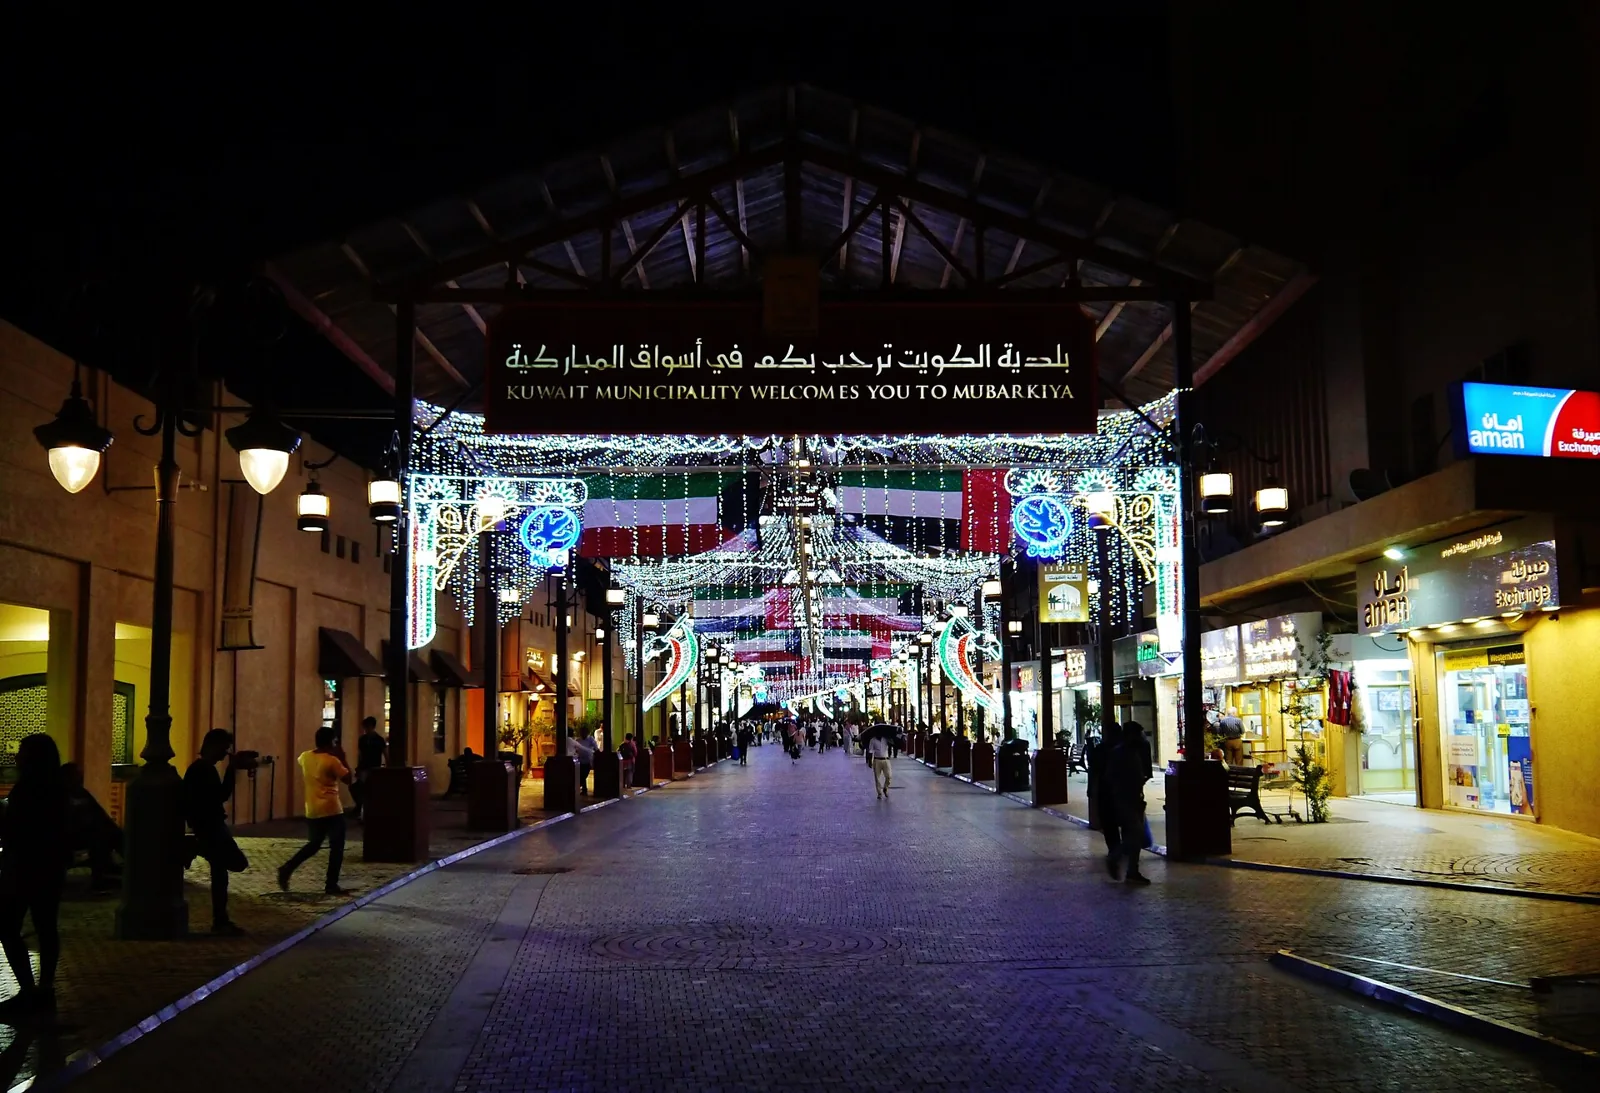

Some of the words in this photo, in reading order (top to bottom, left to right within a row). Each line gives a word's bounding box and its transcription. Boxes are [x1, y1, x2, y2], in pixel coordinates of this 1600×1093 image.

[505, 342, 624, 376] المباركية
[629, 336, 703, 376] أسواق
[706, 343, 743, 376] في
[752, 342, 816, 375] بكم
[821, 342, 893, 376] ترحب
[897, 342, 991, 377] الكويت
[997, 341, 1071, 376] بلدية
[506, 384, 590, 401] KUWAIT
[595, 384, 743, 401] MUNICIPALITY
[750, 384, 860, 401] WELCOMES
[867, 384, 910, 400] YOU
[916, 384, 948, 400] TO
[953, 384, 1075, 400] MUBARKIYA
[1470, 429, 1525, 449] aman
[1363, 596, 1411, 629] aman
[1495, 585, 1551, 608] Exchange
